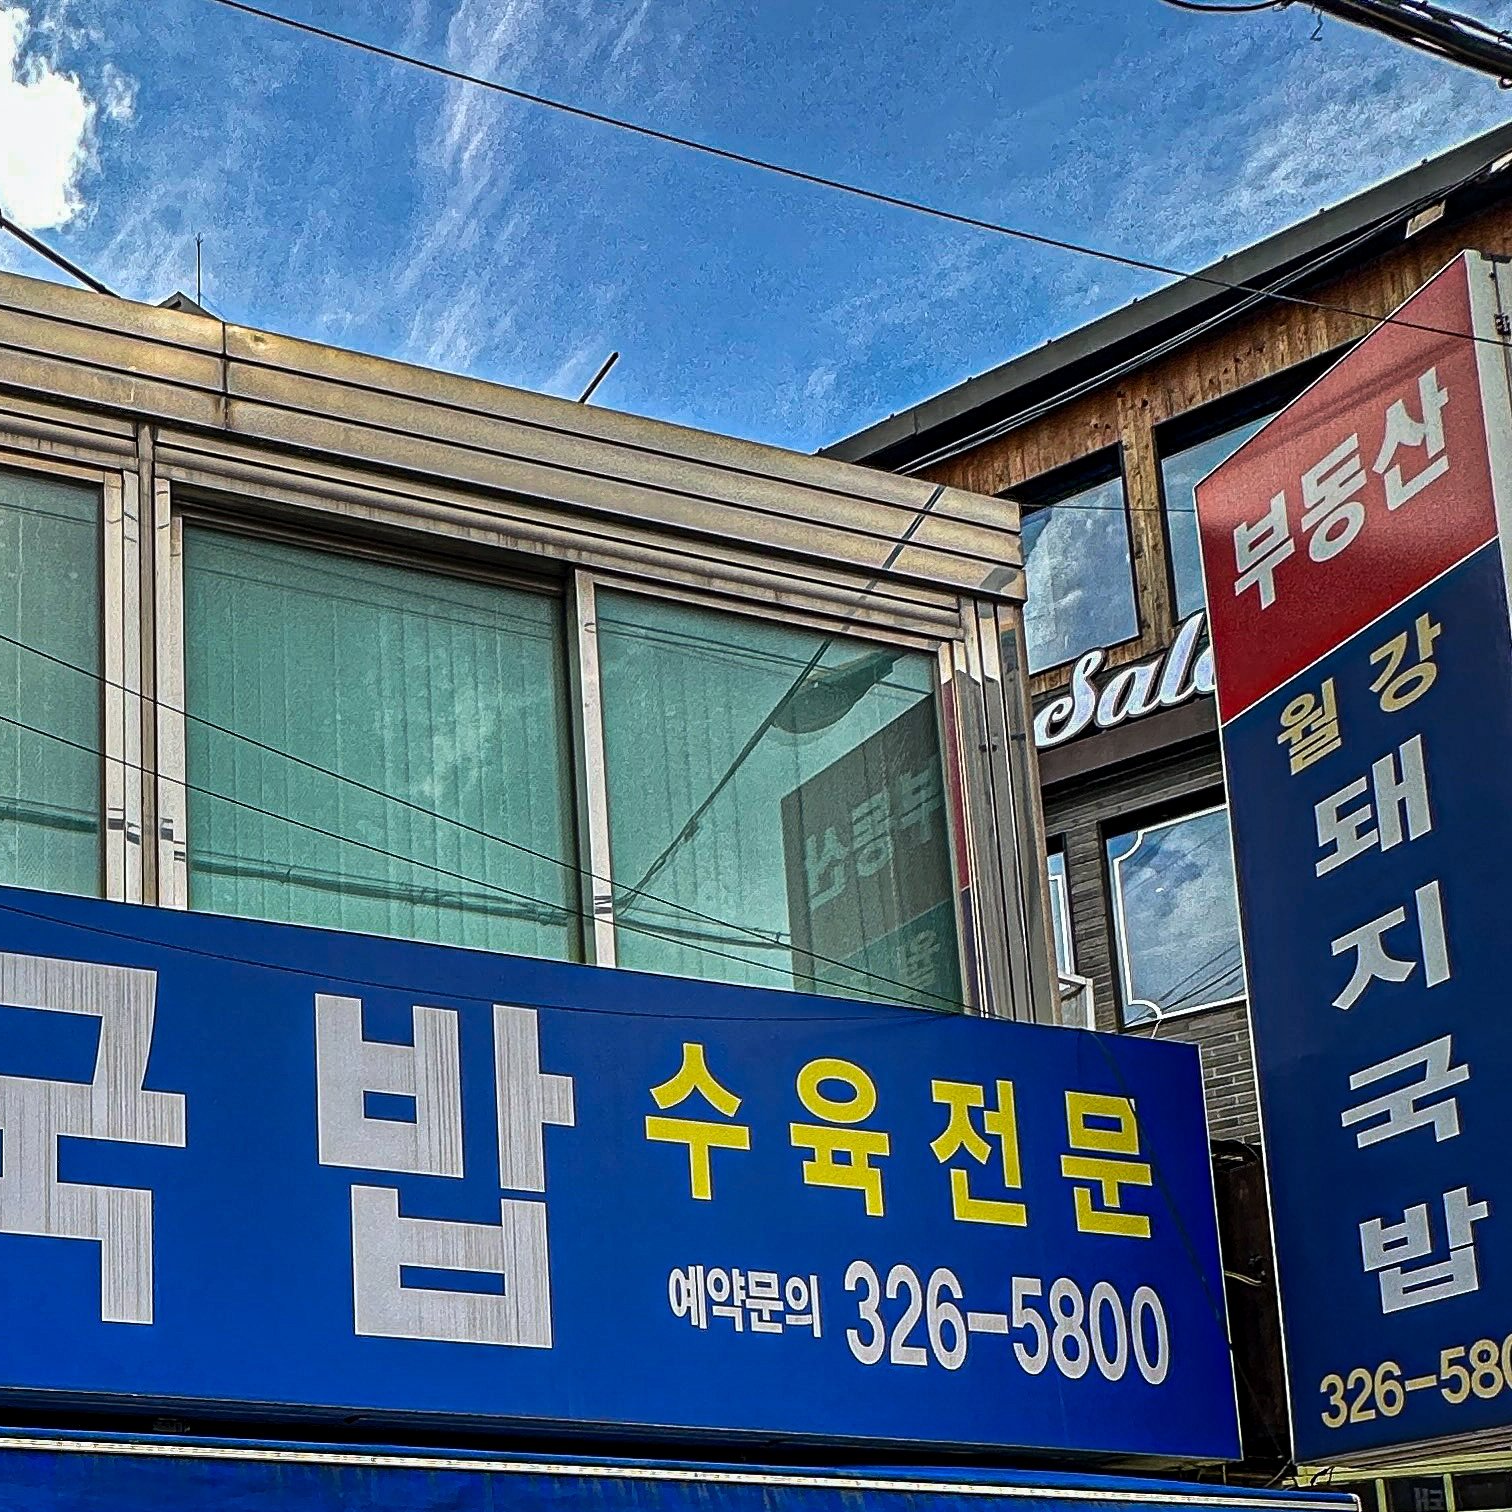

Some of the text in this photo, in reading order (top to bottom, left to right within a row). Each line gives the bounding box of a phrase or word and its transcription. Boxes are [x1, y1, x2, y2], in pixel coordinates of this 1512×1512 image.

[1232, 367, 1449, 611] 부동산
[668, 1260, 1169, 1385] 예약문의 326-5800
